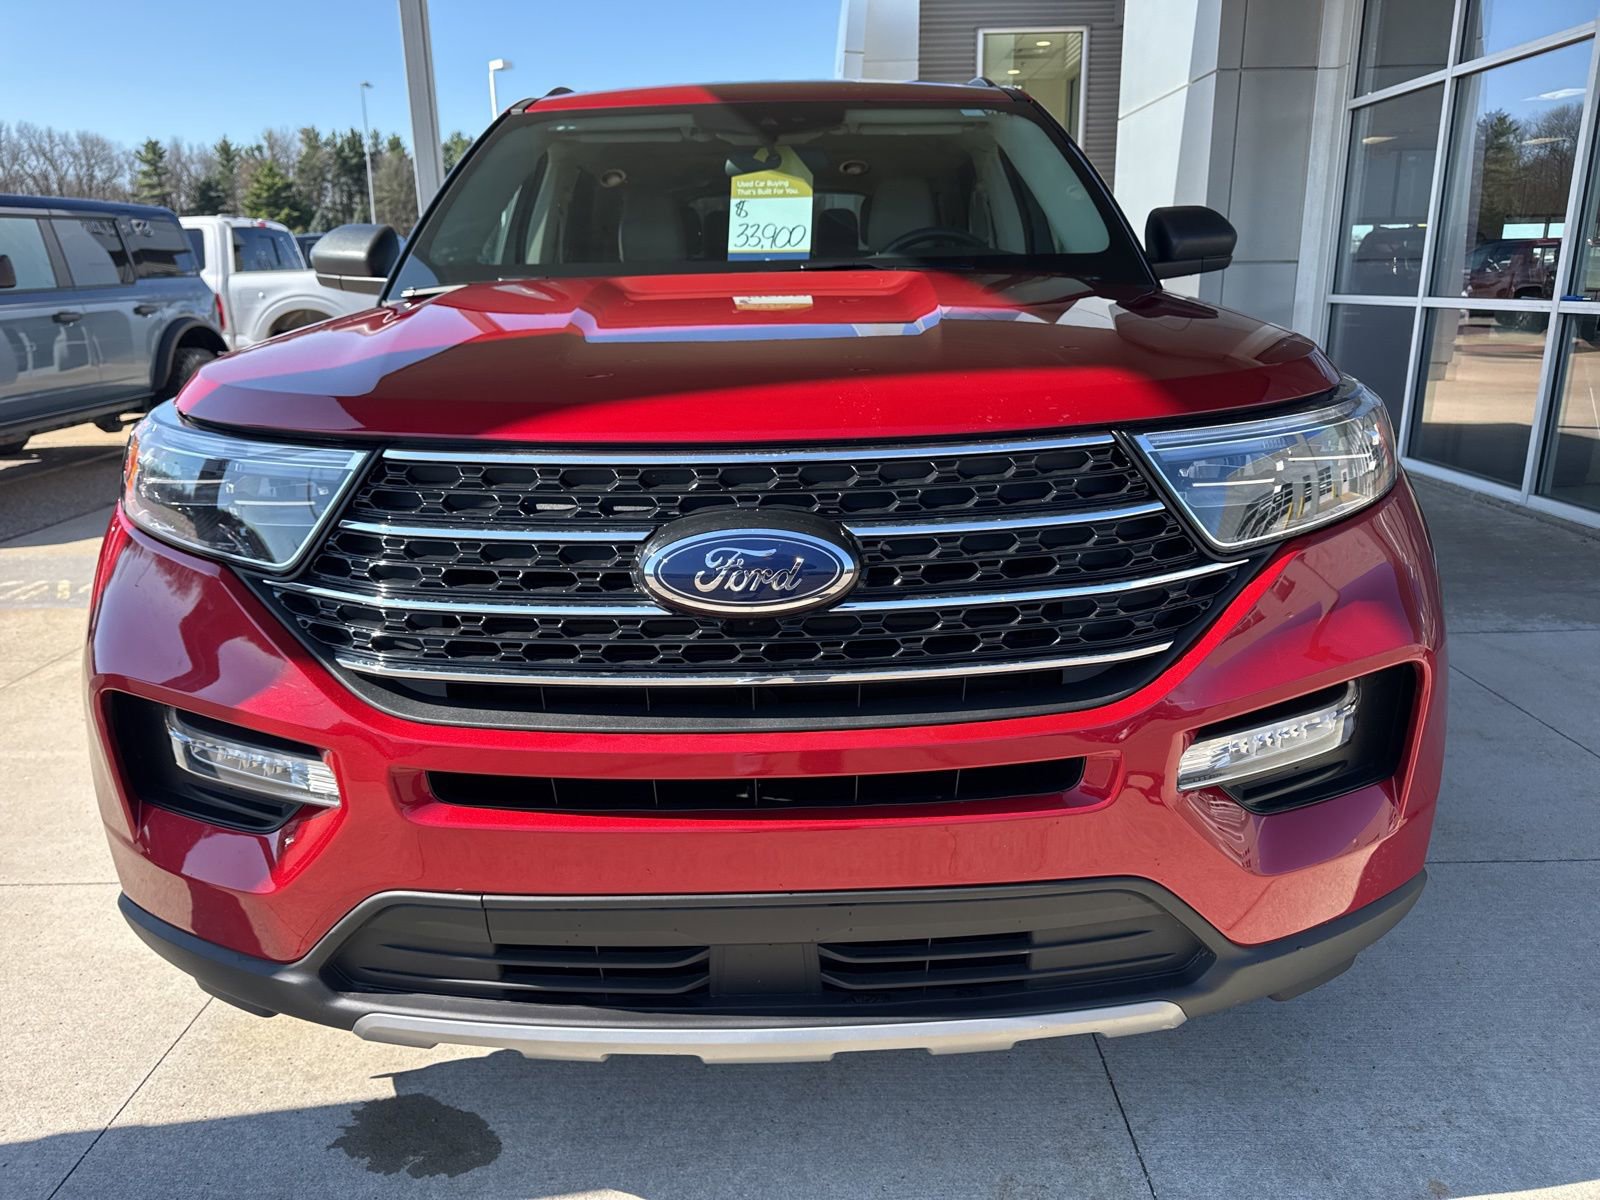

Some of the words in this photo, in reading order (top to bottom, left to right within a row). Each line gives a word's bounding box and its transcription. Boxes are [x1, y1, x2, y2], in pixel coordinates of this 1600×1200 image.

[736, 180, 754, 188] Used
[767, 180, 790, 189] Buying
[735, 200, 749, 218] $
[734, 223, 807, 249] 33,900
[694, 547, 805, 592] Ford
